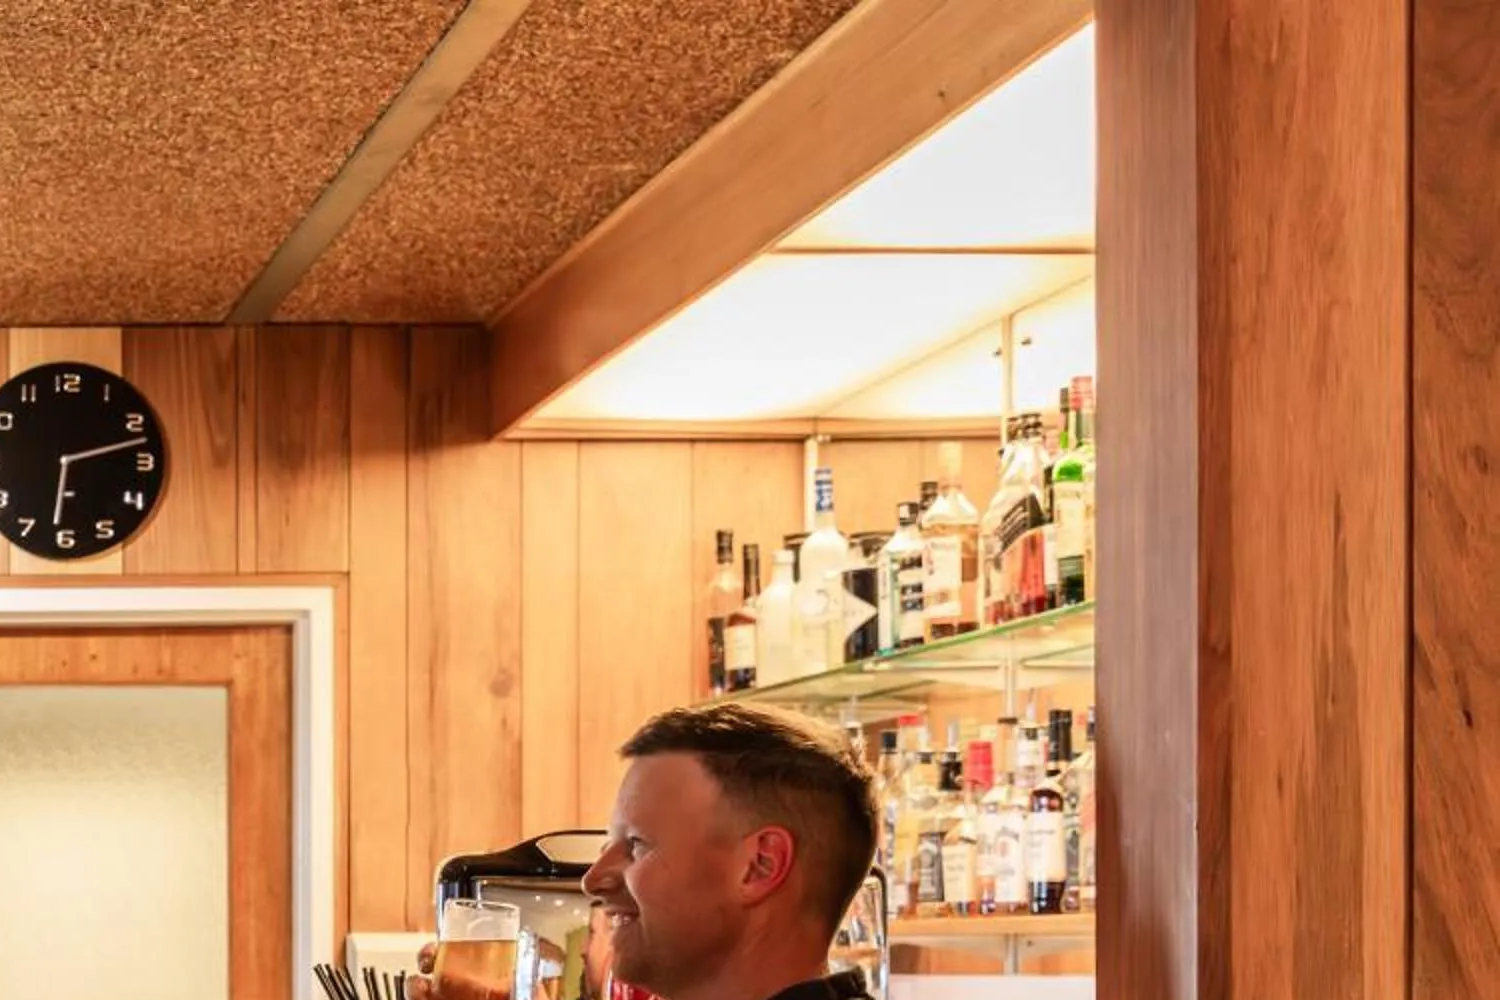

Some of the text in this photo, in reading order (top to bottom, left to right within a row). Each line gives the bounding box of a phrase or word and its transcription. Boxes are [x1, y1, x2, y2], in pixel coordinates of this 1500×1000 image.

[20, 383, 37, 403] 11
[55, 373, 81, 393] 12
[103, 383, 111, 403] 1
[125, 413, 145, 432] 2
[136, 452, 155, 472] 3
[122, 490, 144, 511] 4
[17, 517, 37, 537] 7
[95, 520, 116, 539] 5
[55, 529, 76, 549] 6
